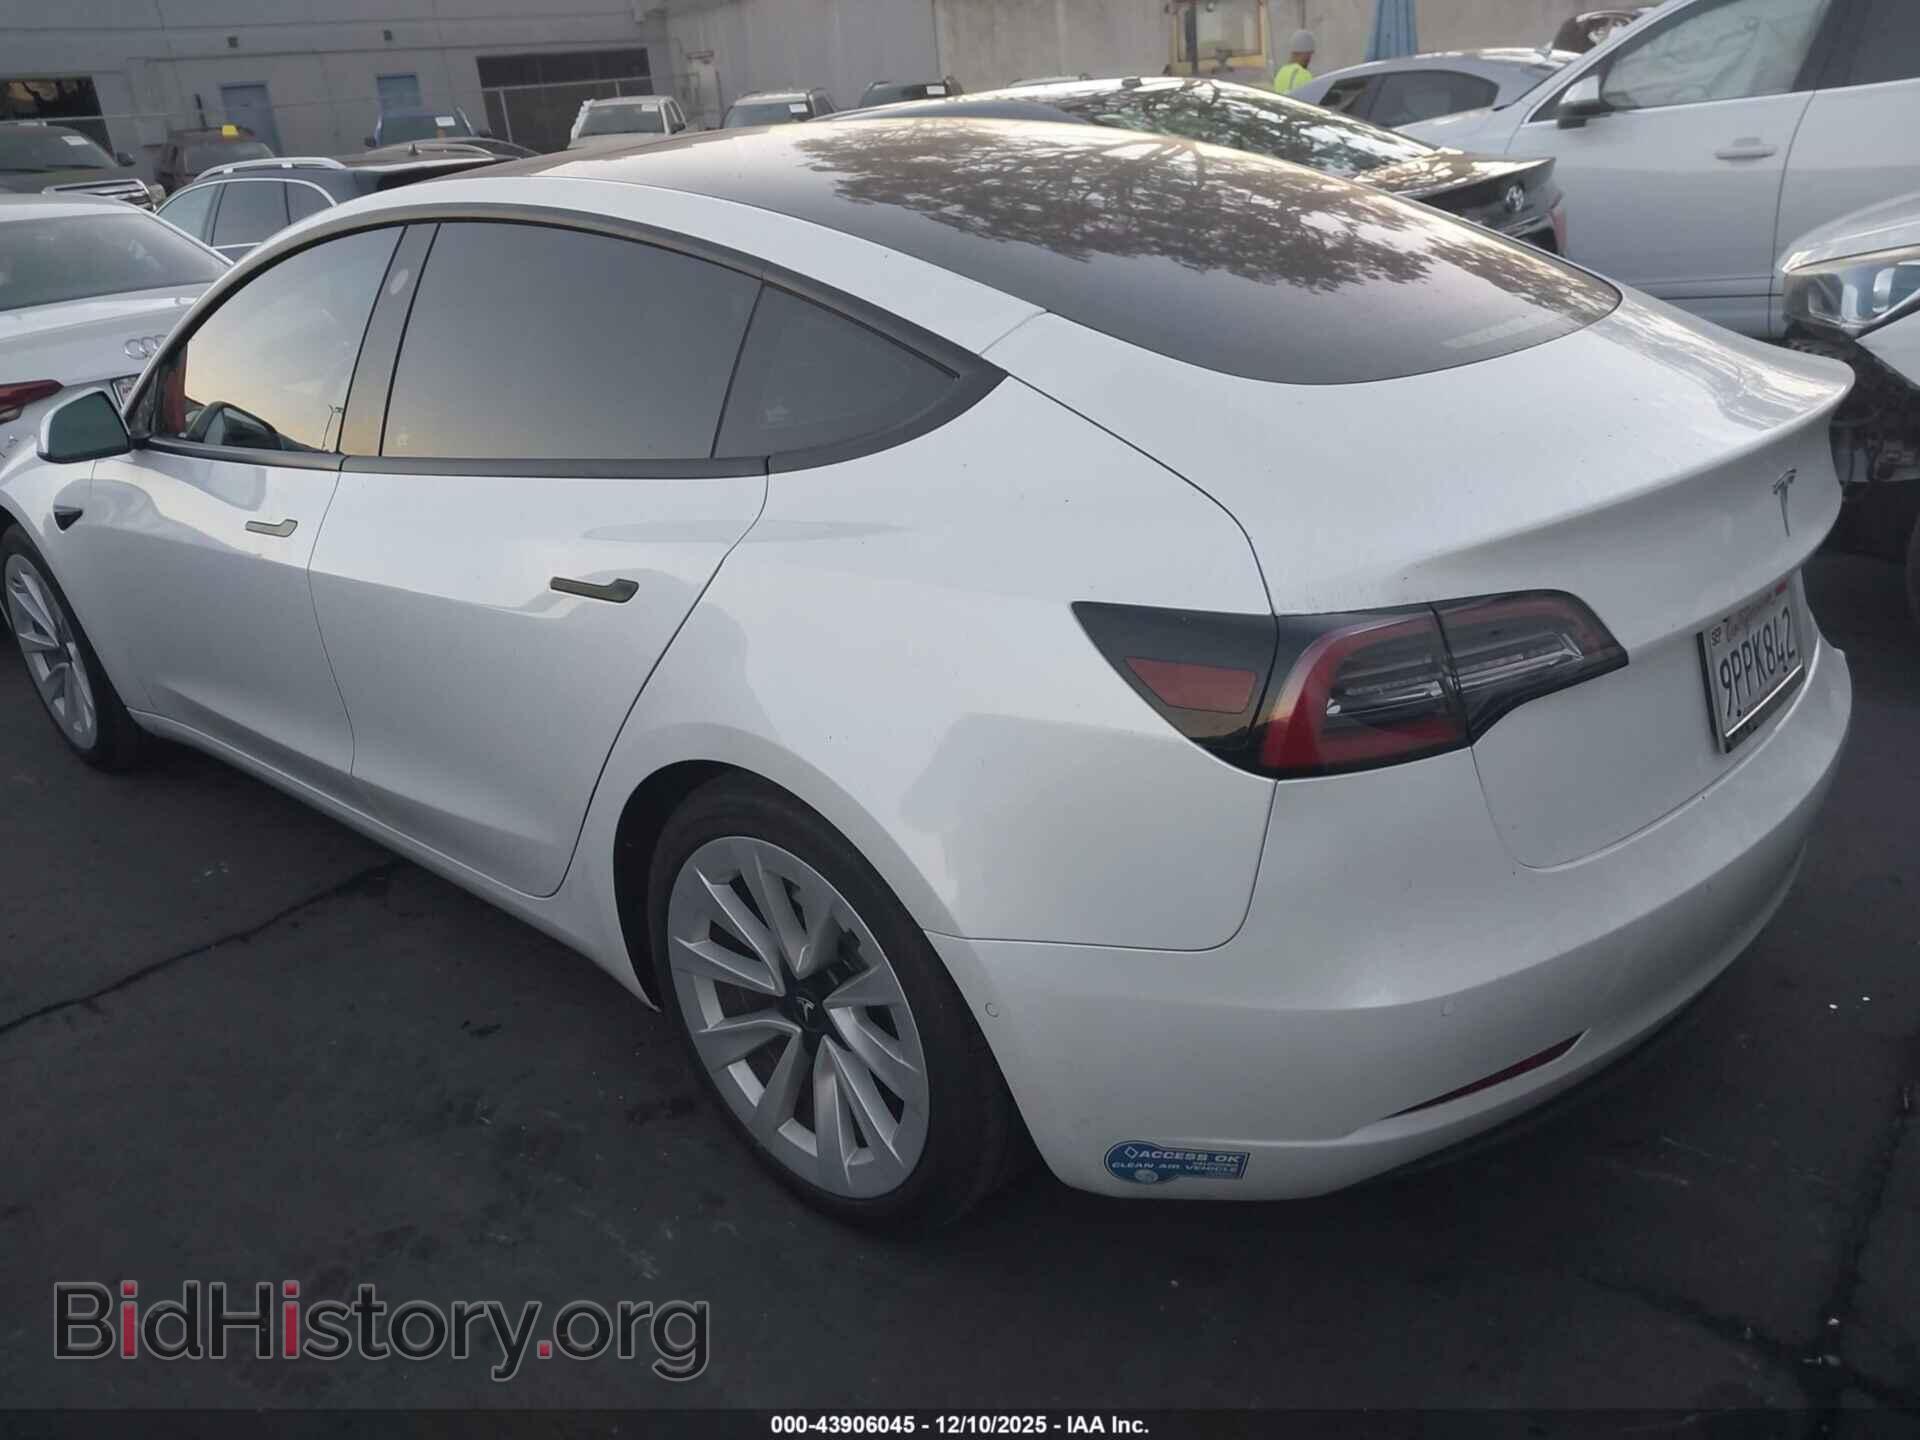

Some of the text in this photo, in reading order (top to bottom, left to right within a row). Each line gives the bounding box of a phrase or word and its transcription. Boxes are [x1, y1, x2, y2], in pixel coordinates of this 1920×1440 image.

[1719, 606, 1796, 717] 9PPK842
[1138, 1150, 1241, 1163] ACCESS OK
[1112, 1161, 1155, 1169] CLEAN
[1185, 1164, 1239, 1172] VEHICLE
